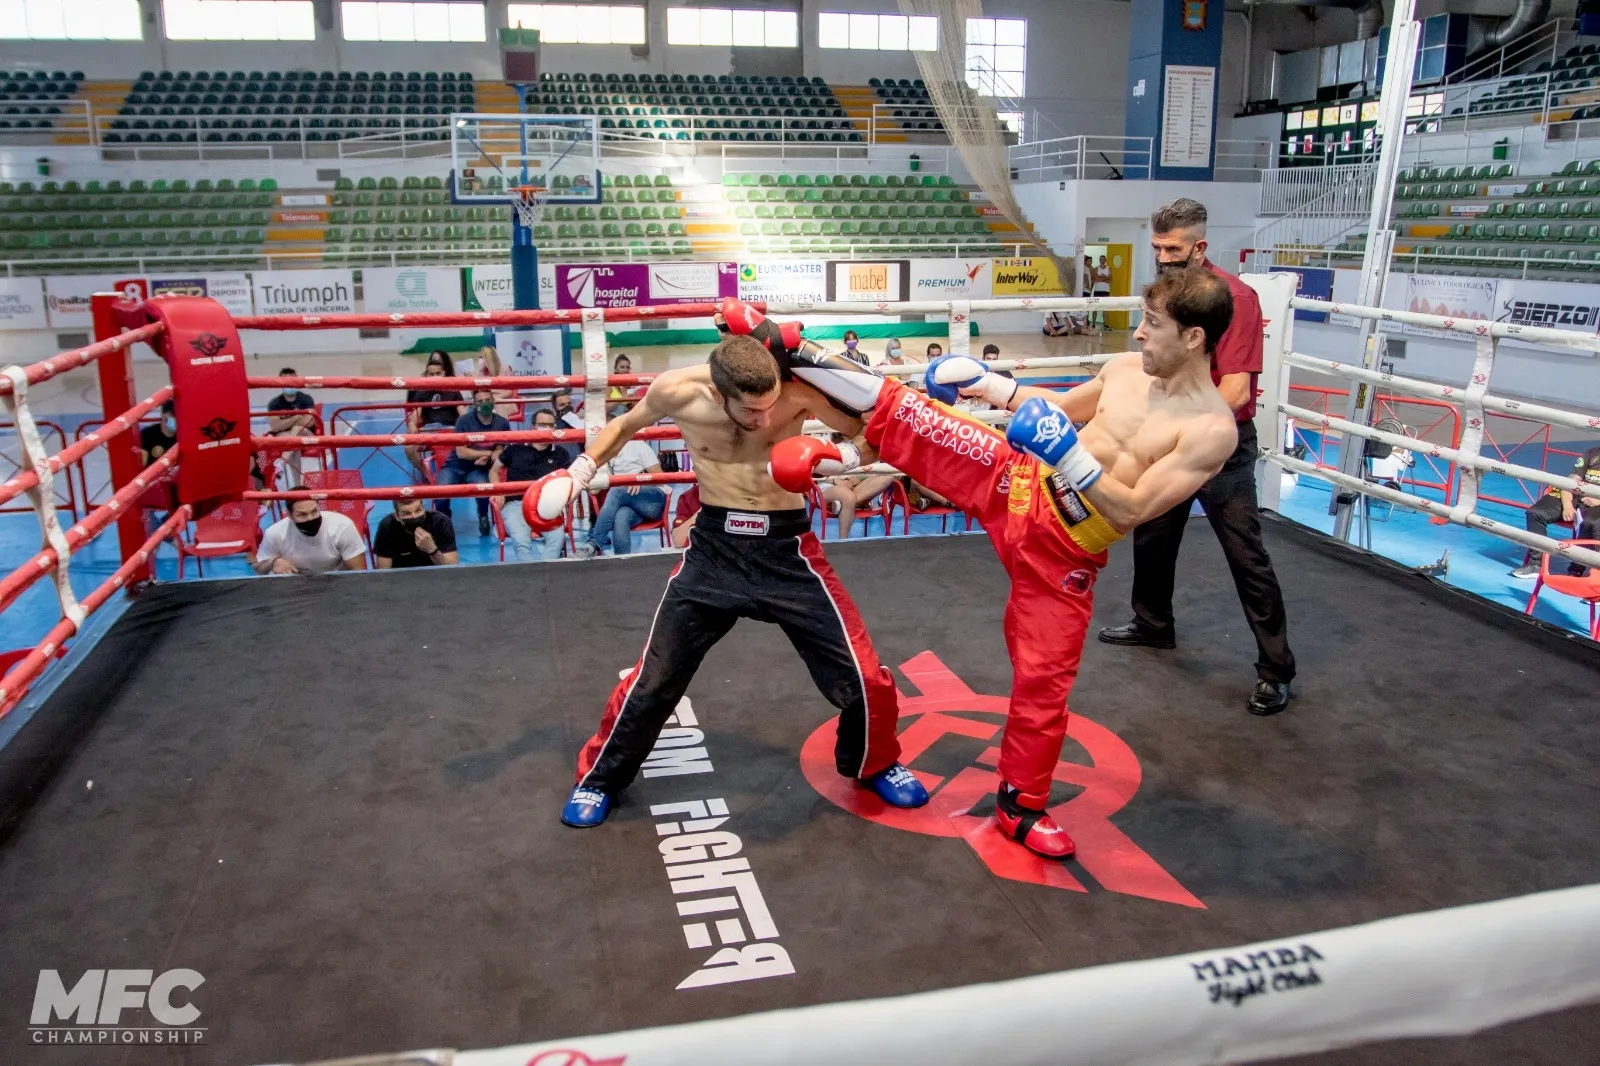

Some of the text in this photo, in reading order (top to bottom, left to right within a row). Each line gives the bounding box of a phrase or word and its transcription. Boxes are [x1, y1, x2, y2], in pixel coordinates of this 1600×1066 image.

[280, 212, 320, 222] Telenauto
[758, 264, 822, 274] EUROMASTER
[541, 277, 553, 289] SL
[849, 267, 888, 290] mabel
[918, 278, 966, 288] PREMIUM
[996, 272, 1039, 285] InterWay
[260, 281, 348, 305] Triumph
[594, 286, 638, 299] hospital
[740, 291, 822, 303] HERMANOS PEÑA
[848, 293, 888, 301] MUEBLES
[387, 298, 438, 308] alda hotels
[609, 298, 636, 308] reina
[901, 392, 1001, 452] BARYMONT
[729, 519, 764, 529] TOP TEN
[650, 797, 796, 990] FIGHTER
[1190, 944, 1326, 981] MAMBA
[1207, 975, 1267, 1007] Fight
